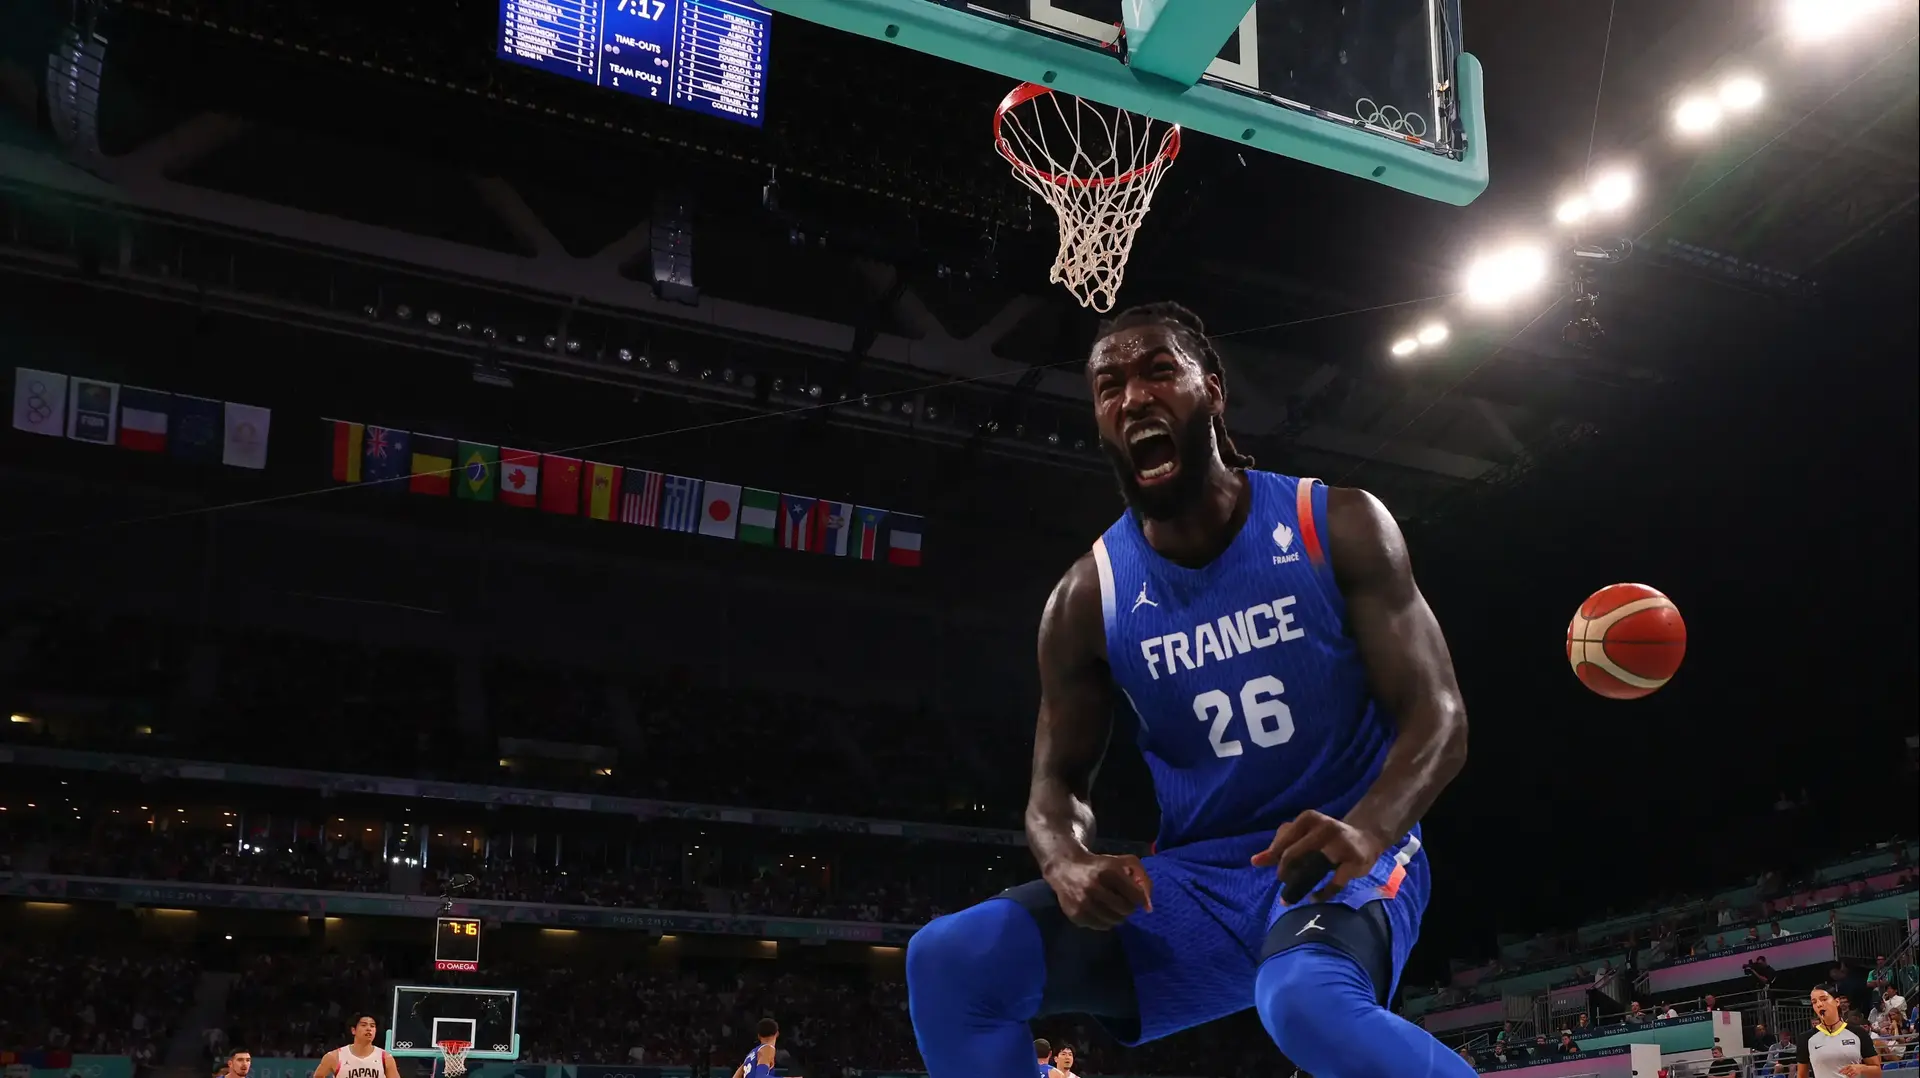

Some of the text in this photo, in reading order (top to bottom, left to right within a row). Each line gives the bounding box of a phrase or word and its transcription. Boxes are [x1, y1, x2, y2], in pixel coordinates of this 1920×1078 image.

[615, 34, 661, 54] TIME-OUTS
[609, 63, 662, 85] TEAM FOULS
[613, 77, 657, 96] 1 2
[1272, 552, 1300, 565] FRANCE
[1140, 595, 1304, 680] FRANCE
[1192, 674, 1295, 758] 26
[450, 922, 477, 936] 7:16
[447, 963, 476, 971] OMEGA
[346, 1067, 379, 1078] JAPAN
